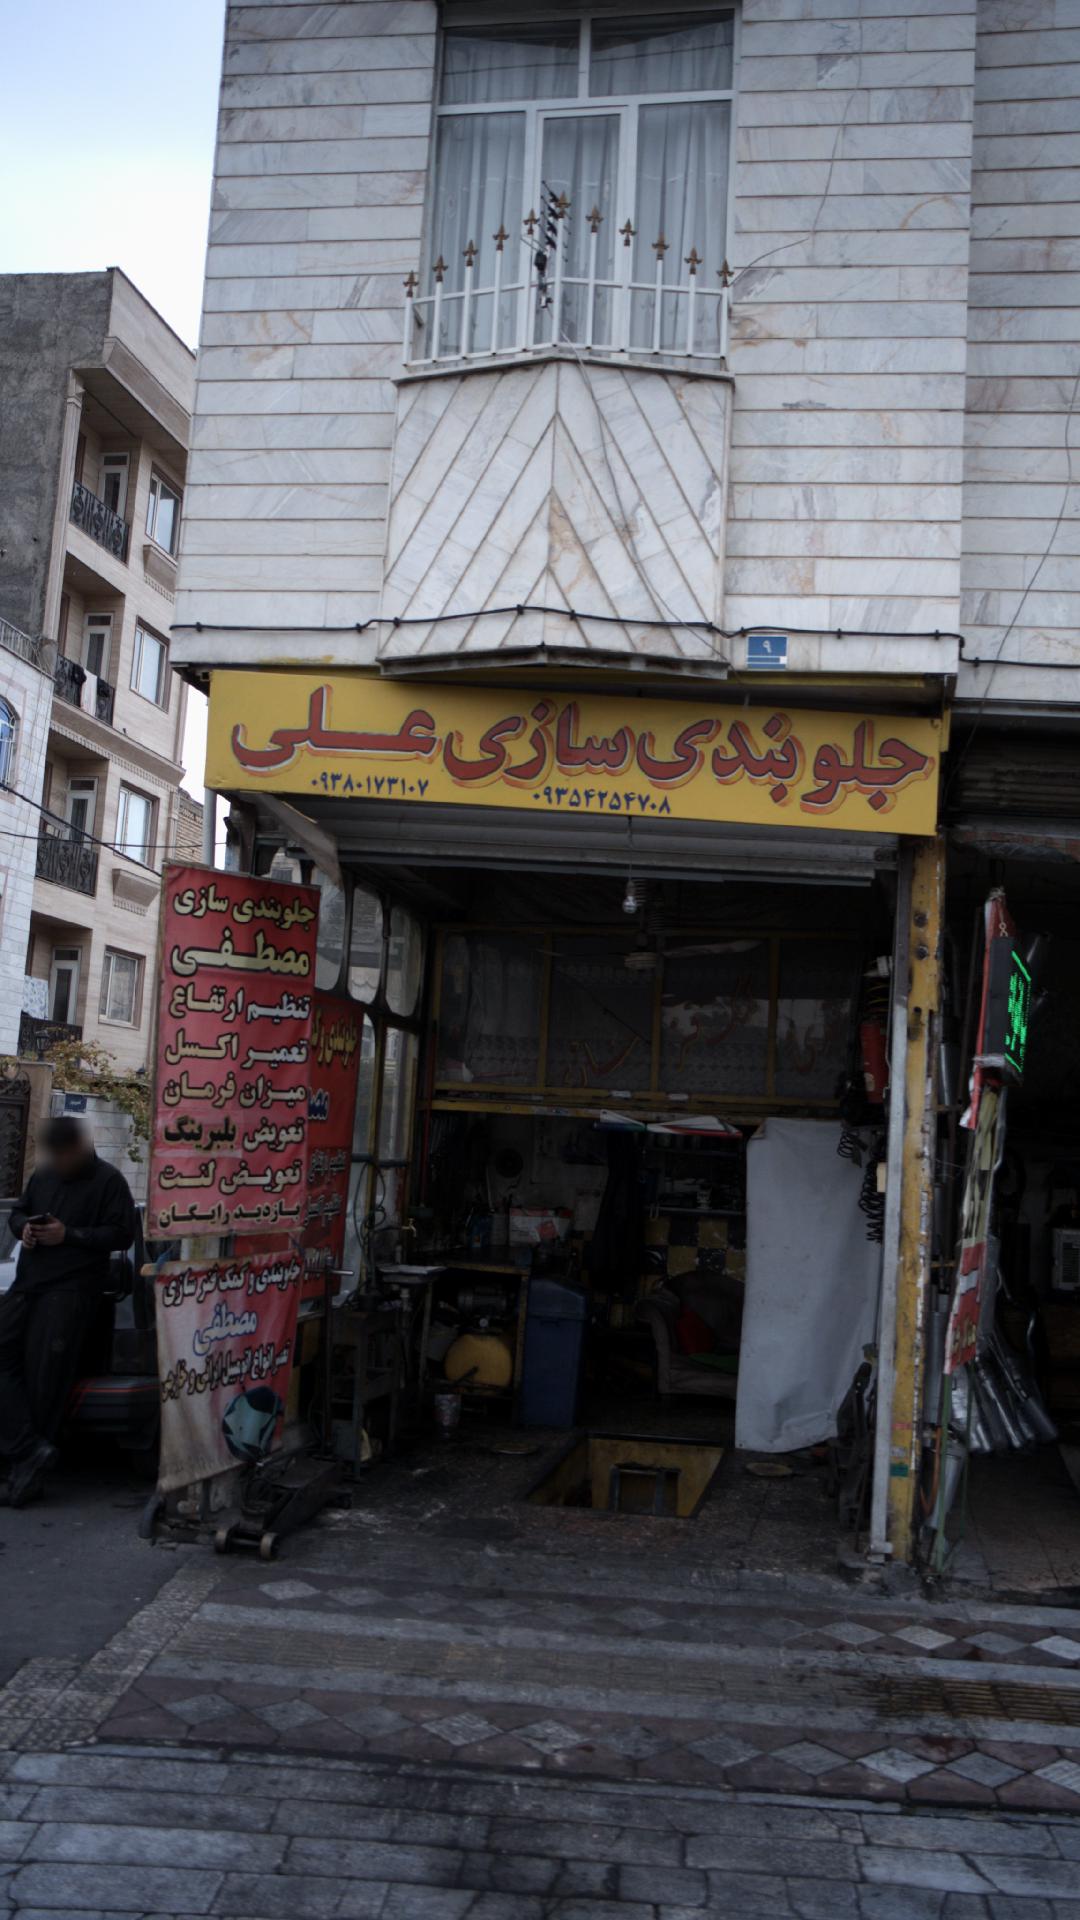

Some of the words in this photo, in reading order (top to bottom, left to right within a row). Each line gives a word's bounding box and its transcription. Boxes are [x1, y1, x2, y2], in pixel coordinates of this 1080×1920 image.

[231, 683, 440, 777] علی
[443, 700, 636, 788] سازی
[636, 711, 935, 816] جلوبندی
[311, 771, 430, 797] ۰۹۳۸۰۱۷۳۱۰۷
[532, 785, 672, 815] ۰۹۳۵۴۲۵۴۷۰۸
[173, 883, 229, 918] سازی
[231, 896, 317, 931] جلوبندی
[171, 927, 310, 977] مصطفی
[169, 982, 245, 1022] ارتفاع
[246, 991, 311, 1024] تنظیم
[165, 1028, 239, 1065] اکسل
[241, 1039, 308, 1069] تعمیر
[163, 1070, 237, 1108] فرمان
[238, 1074, 307, 1109] میزان
[164, 1114, 237, 1150] بلبرینگ
[242, 1116, 306, 1151] تعویض
[159, 1160, 216, 1190] لنت
[218, 1160, 303, 1195] تعویض
[159, 1203, 230, 1228] رایگان
[233, 1200, 302, 1224] بازدید
[163, 1268, 198, 1307] سازی
[193, 1301, 259, 1356] مصطفی
